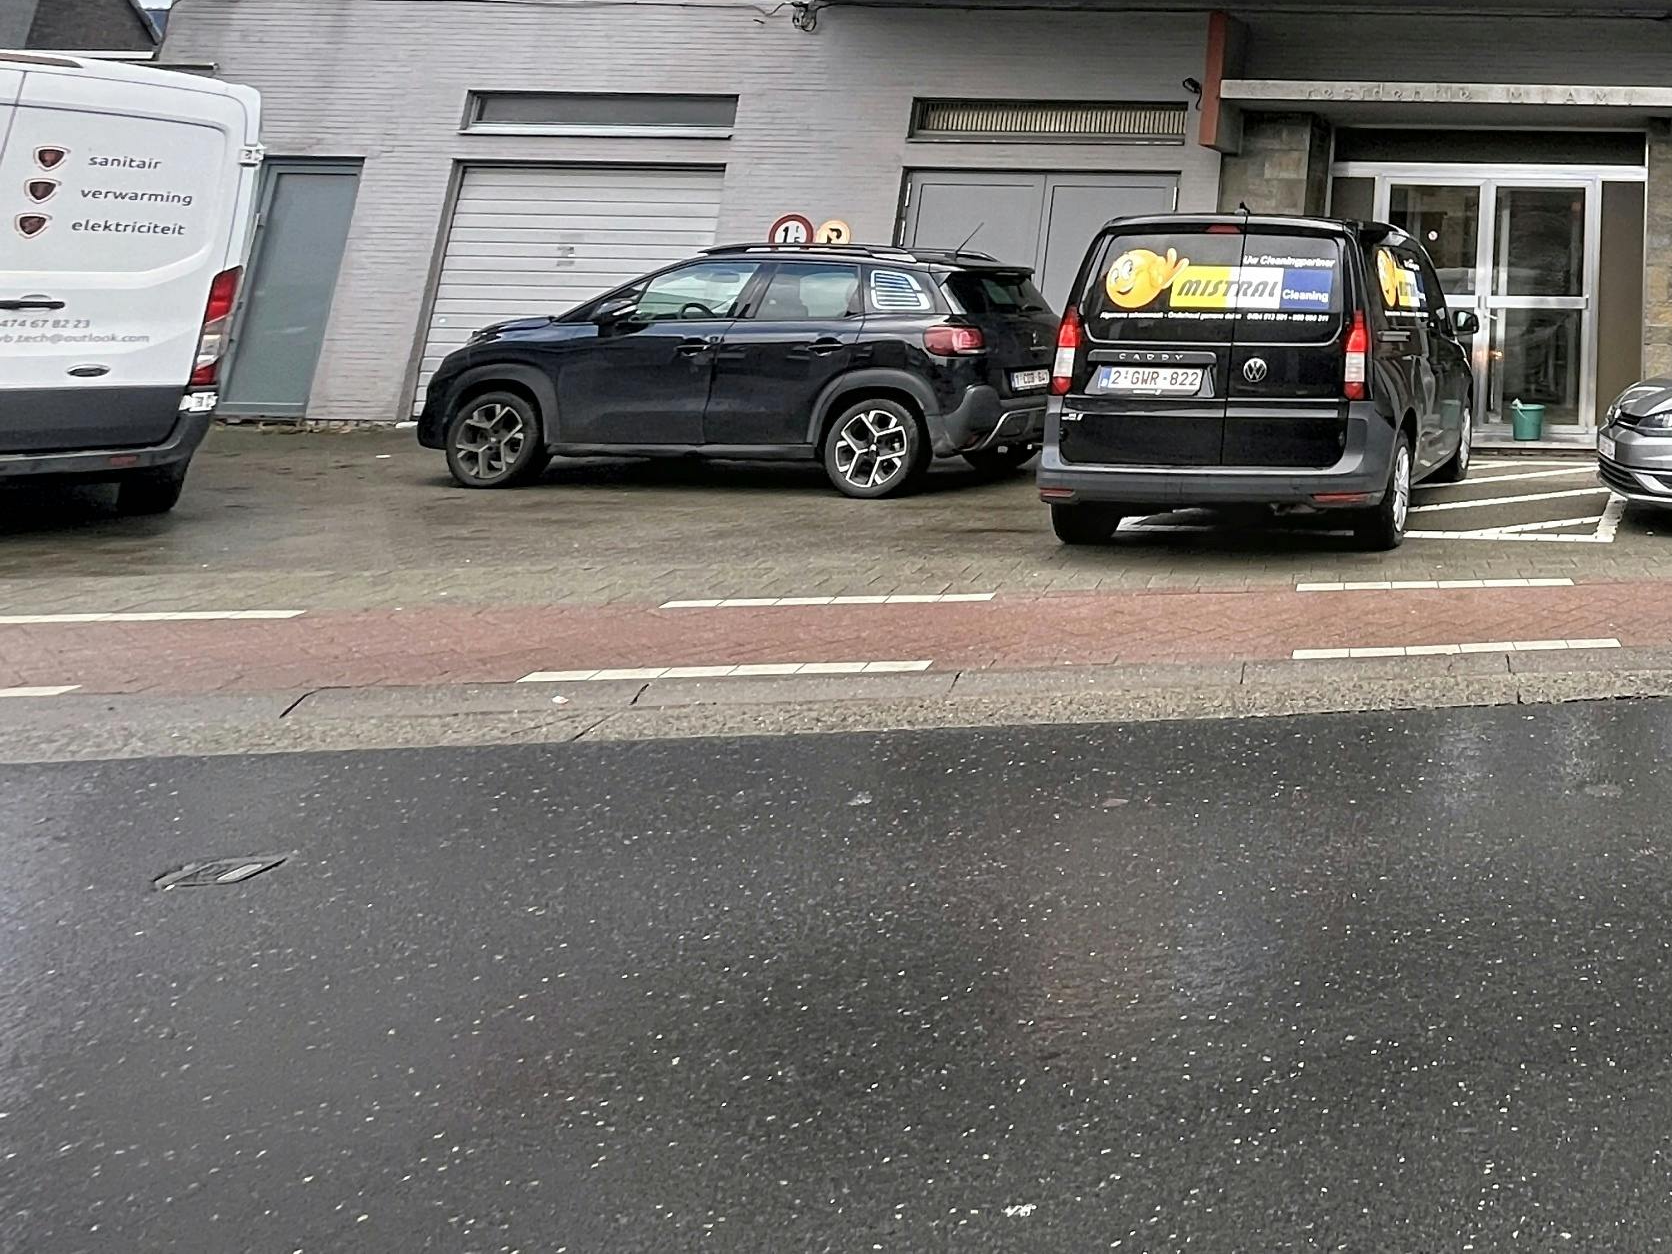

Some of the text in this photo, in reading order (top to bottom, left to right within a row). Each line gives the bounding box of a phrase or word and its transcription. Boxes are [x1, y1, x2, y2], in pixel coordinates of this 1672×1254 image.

[88, 156, 162, 169] sanitair
[81, 189, 193, 206] verwarming
[71, 219, 186, 235] elektriciteit
[1243, 255, 1336, 268] Uw Cleaningpartner
[1177, 279, 1279, 298] MISTRAL
[1282, 289, 1329, 302] Cleaning
[1119, 353, 1184, 361] CADDY
